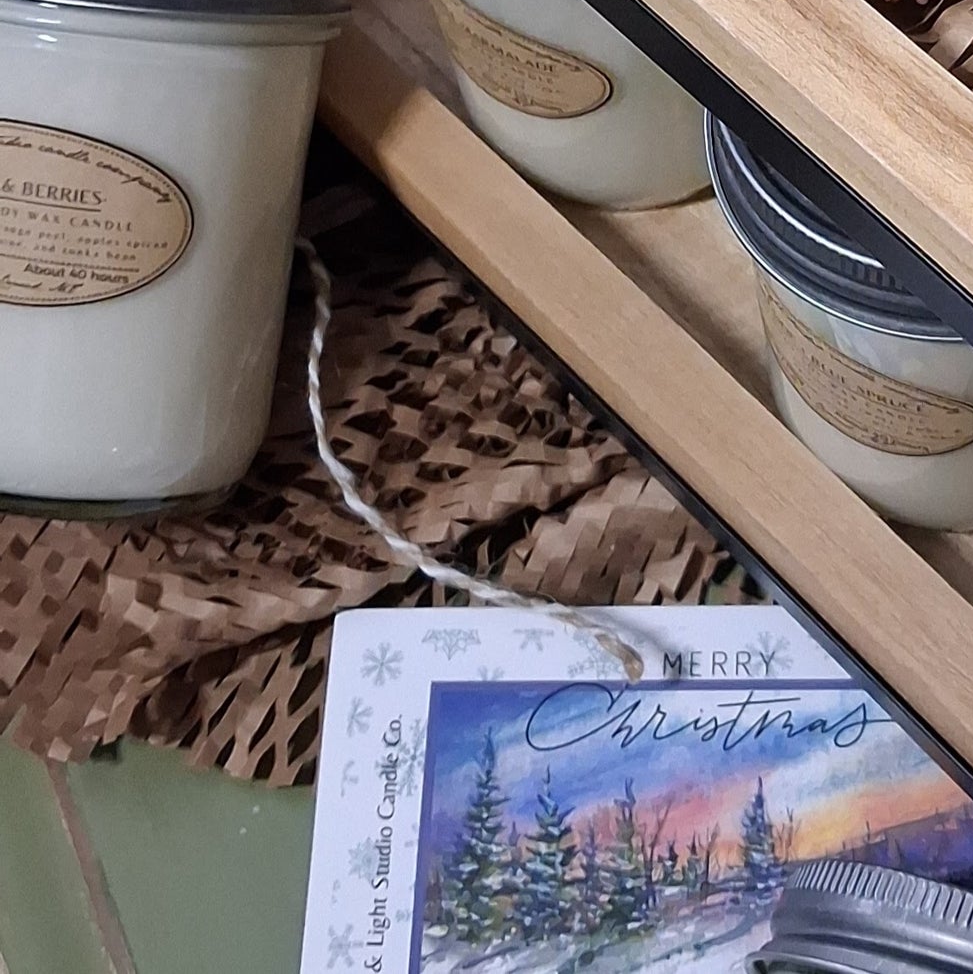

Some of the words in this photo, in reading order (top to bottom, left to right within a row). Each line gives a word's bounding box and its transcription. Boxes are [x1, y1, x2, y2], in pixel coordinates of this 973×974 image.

[38, 144, 91, 164] candle
[2, 178, 14, 194] &
[28, 210, 60, 224] WAX
[70, 216, 133, 233] CANDLE
[24, 262, 65, 278] About
[69, 267, 87, 281] 40
[90, 269, 130, 285] hours
[662, 650, 777, 678] MERRY
[526, 681, 898, 752] Christmas
[383, 714, 402, 748] Co.
[377, 751, 400, 821] Candle
[372, 825, 393, 890] Studio
[367, 897, 391, 947] Light
[364, 954, 383, 974] &
